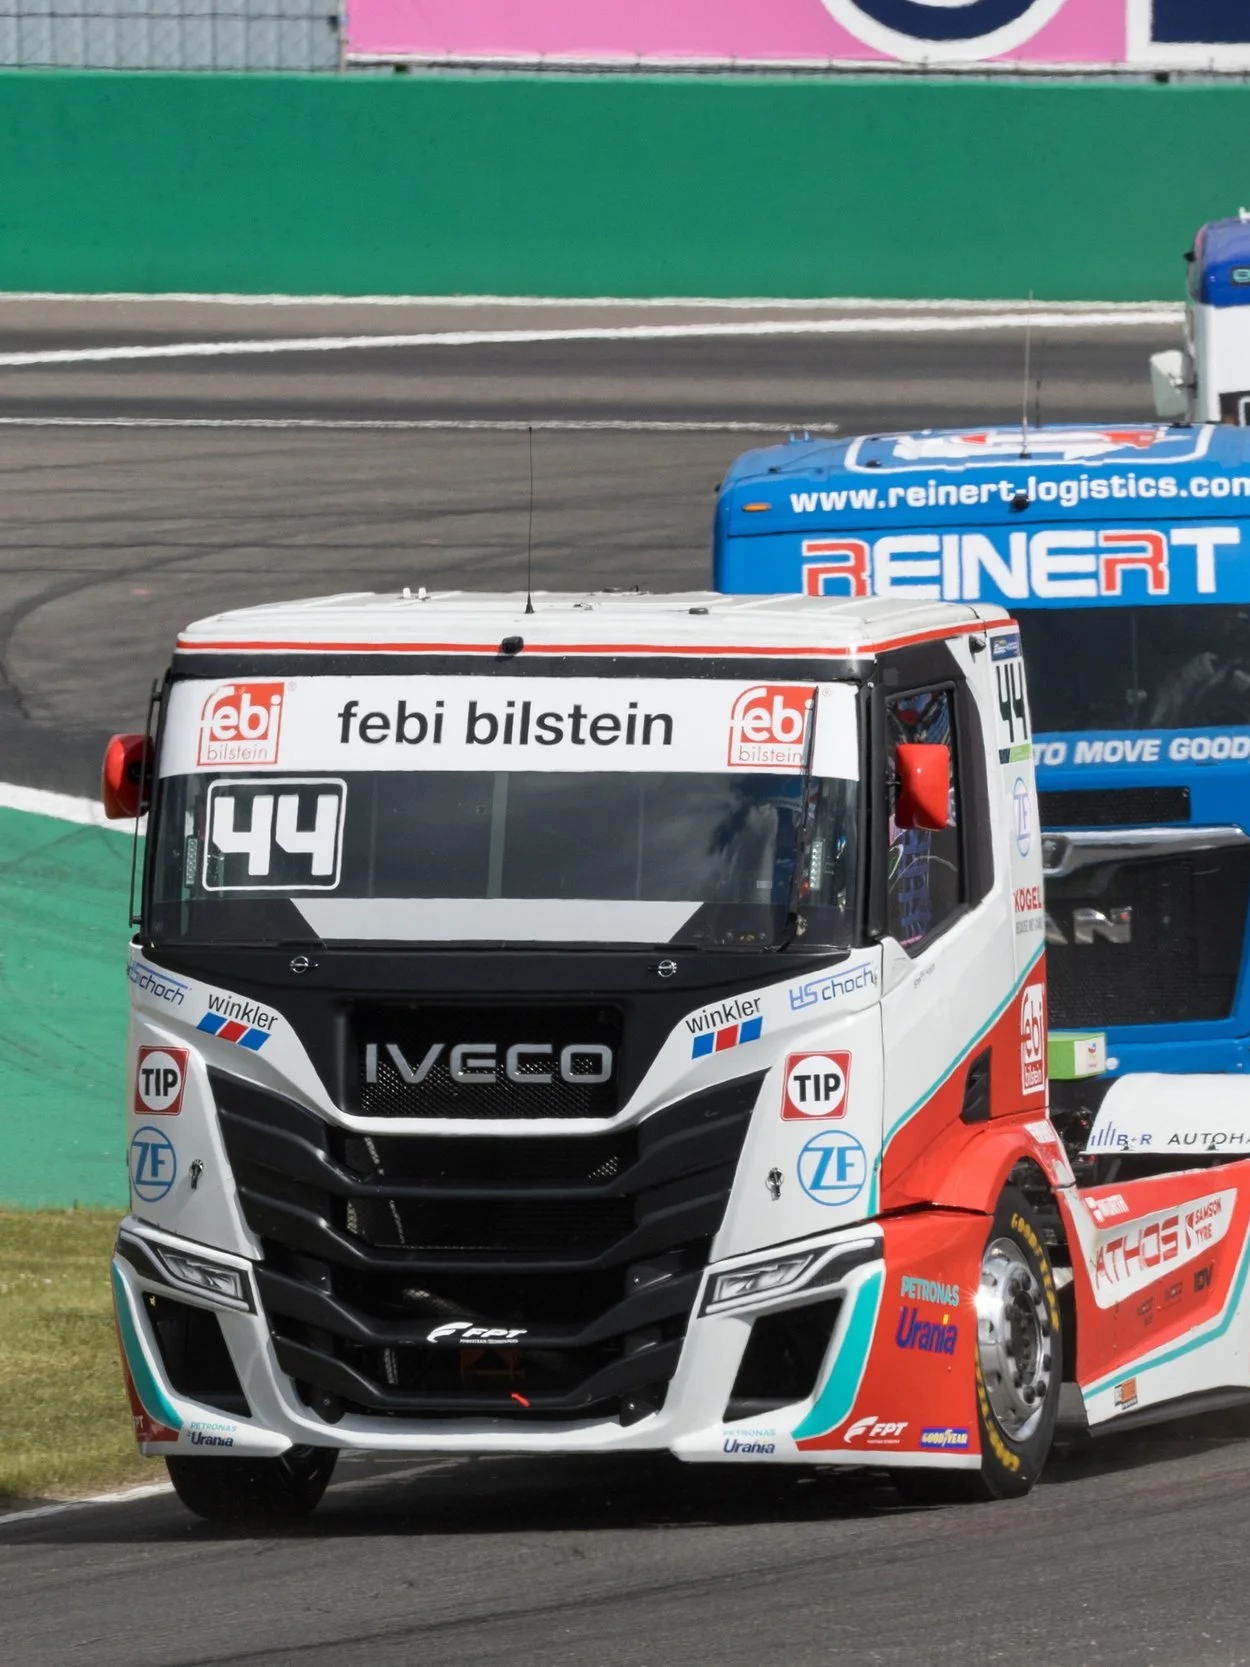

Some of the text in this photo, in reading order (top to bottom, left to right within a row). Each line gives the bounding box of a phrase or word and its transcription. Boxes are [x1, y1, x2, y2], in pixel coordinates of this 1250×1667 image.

[802, 527, 1241, 601] REINERT
[203, 686, 282, 741] febi
[996, 661, 1028, 743] 44
[337, 700, 674, 746] febi bilstein
[207, 743, 268, 762] bilstein
[738, 745, 803, 763] bilstein
[1032, 741, 1067, 766] TO
[1073, 739, 1161, 764] MOVE
[212, 794, 339, 876] 44
[208, 994, 278, 1031] winkler
[685, 997, 761, 1034] winkler
[365, 1043, 613, 1084] IVECO
[142, 1068, 178, 1096] TIP
[793, 1073, 841, 1102] TIP
[132, 1141, 173, 1187] ZF
[803, 1146, 865, 1190] ZF
[1194, 1198, 1222, 1224] SAMSON
[1196, 1223, 1213, 1243] TYRE
[901, 1276, 960, 1306] PETRONAS
[462, 1328, 528, 1338] FPT
[896, 1307, 957, 1355] Urania
[191, 1432, 234, 1447] Urania
[869, 1422, 908, 1437] FPT
[723, 1437, 776, 1454] Urania
